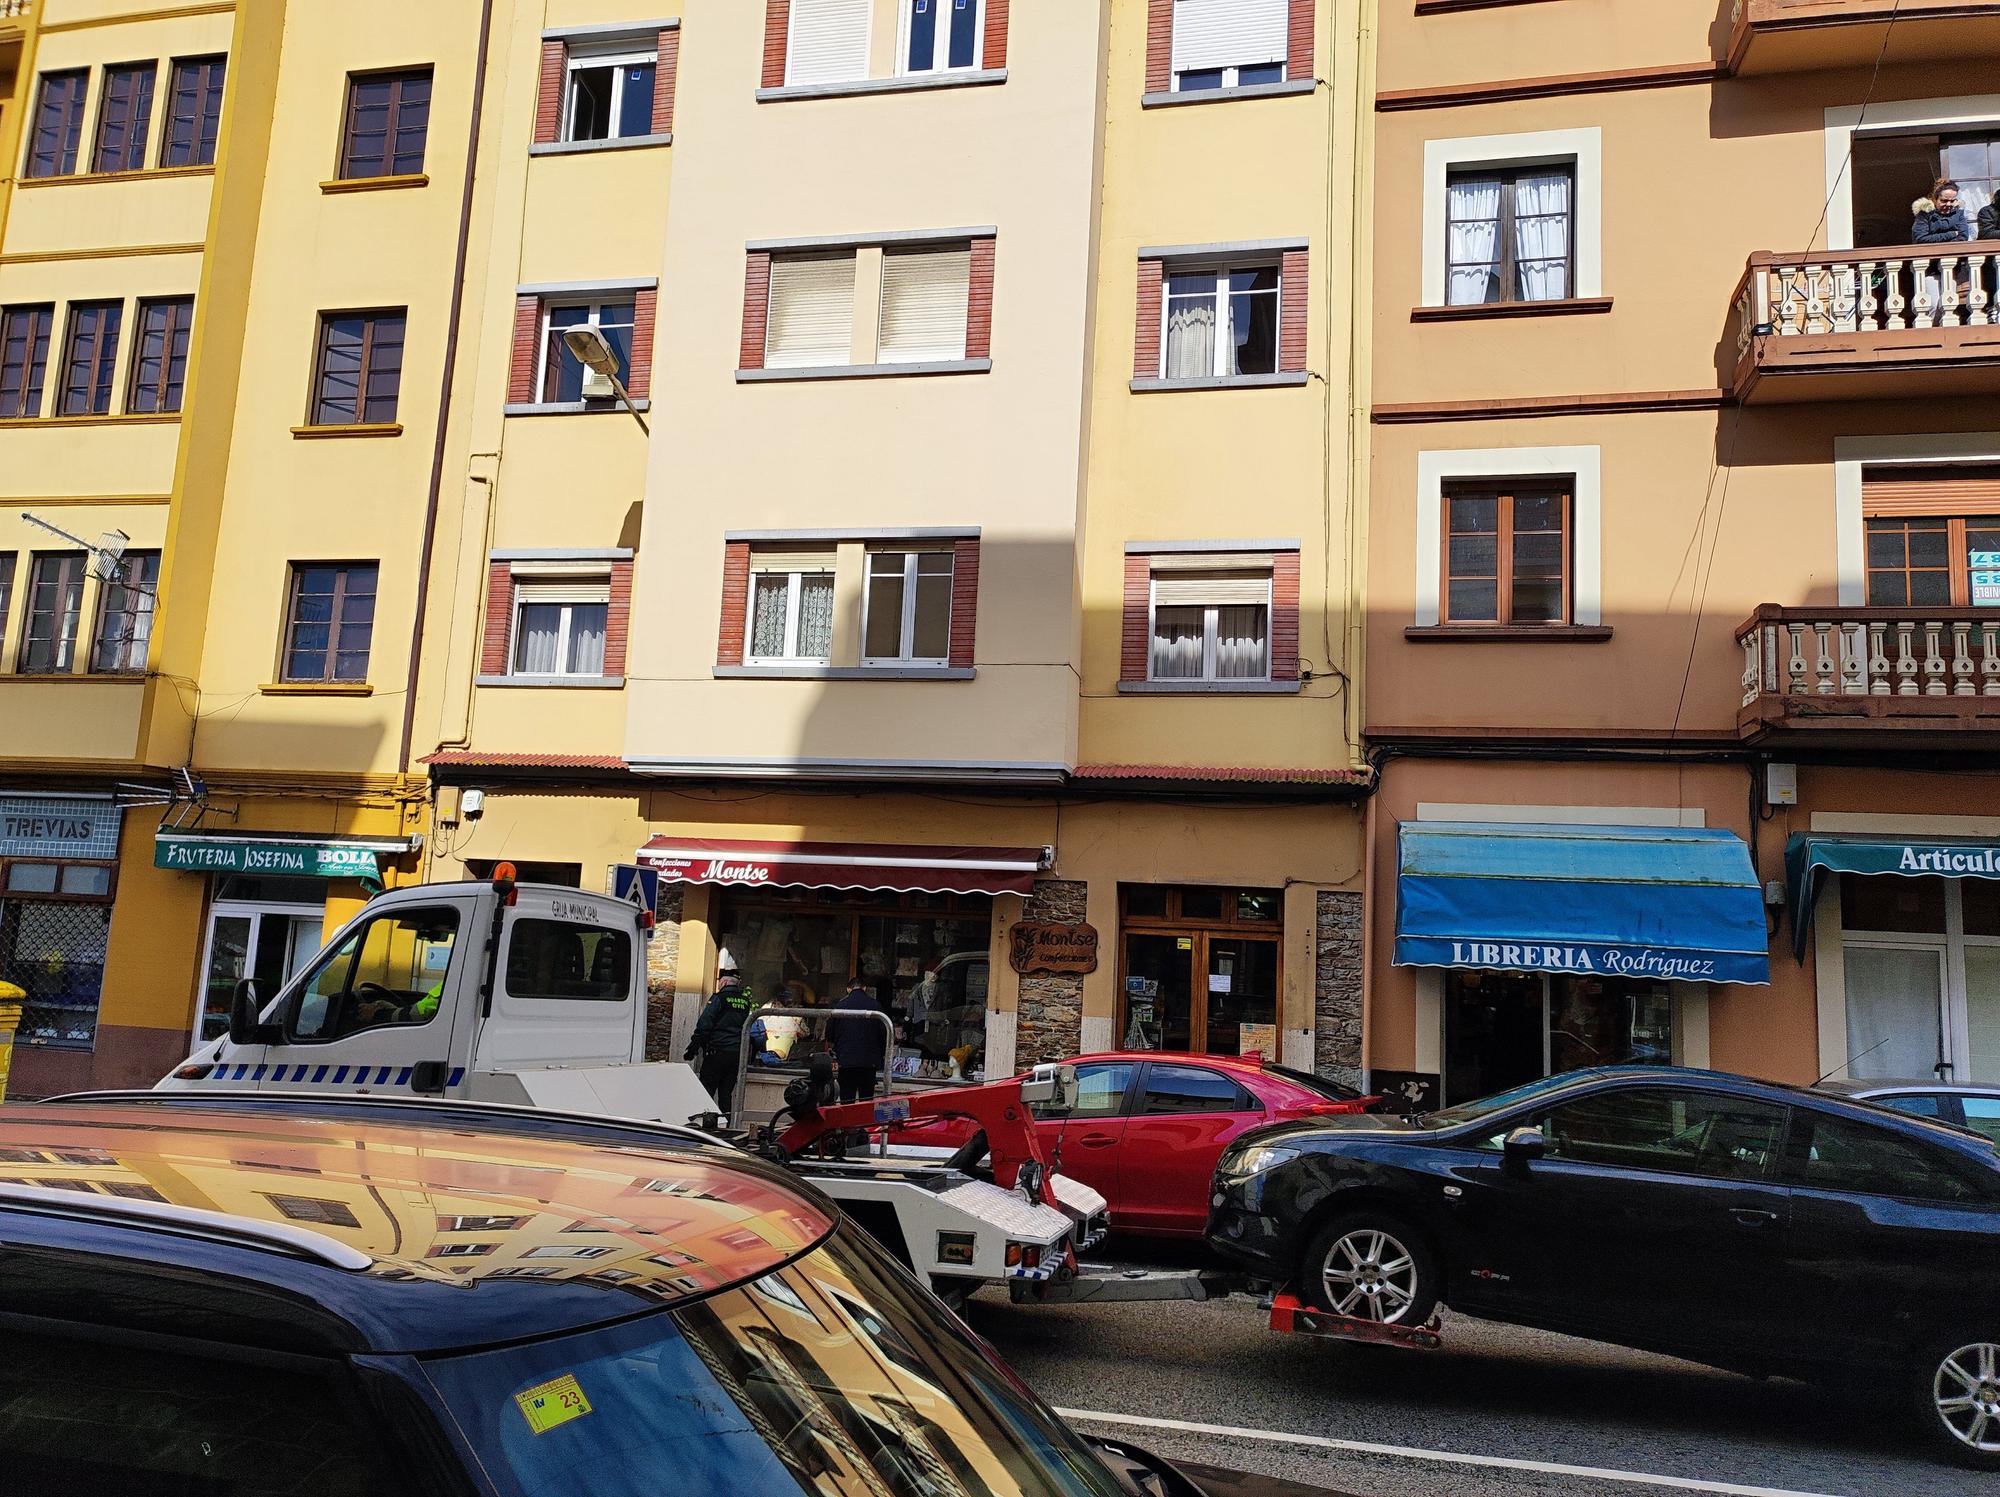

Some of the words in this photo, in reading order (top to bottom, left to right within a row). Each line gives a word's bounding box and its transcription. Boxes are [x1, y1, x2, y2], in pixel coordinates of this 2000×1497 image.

[6, 817, 91, 839] TREVIAS
[167, 844, 236, 866] FRUTERIA
[242, 846, 304, 871] JOSEFINA
[649, 858, 692, 867] Confecciones
[701, 860, 769, 880] Montse
[1038, 929, 1094, 945] Montse
[1451, 943, 1594, 969] LIBRERIA
[1602, 950, 1714, 976] Rodriguez
[560, 1391, 580, 1408] 23
